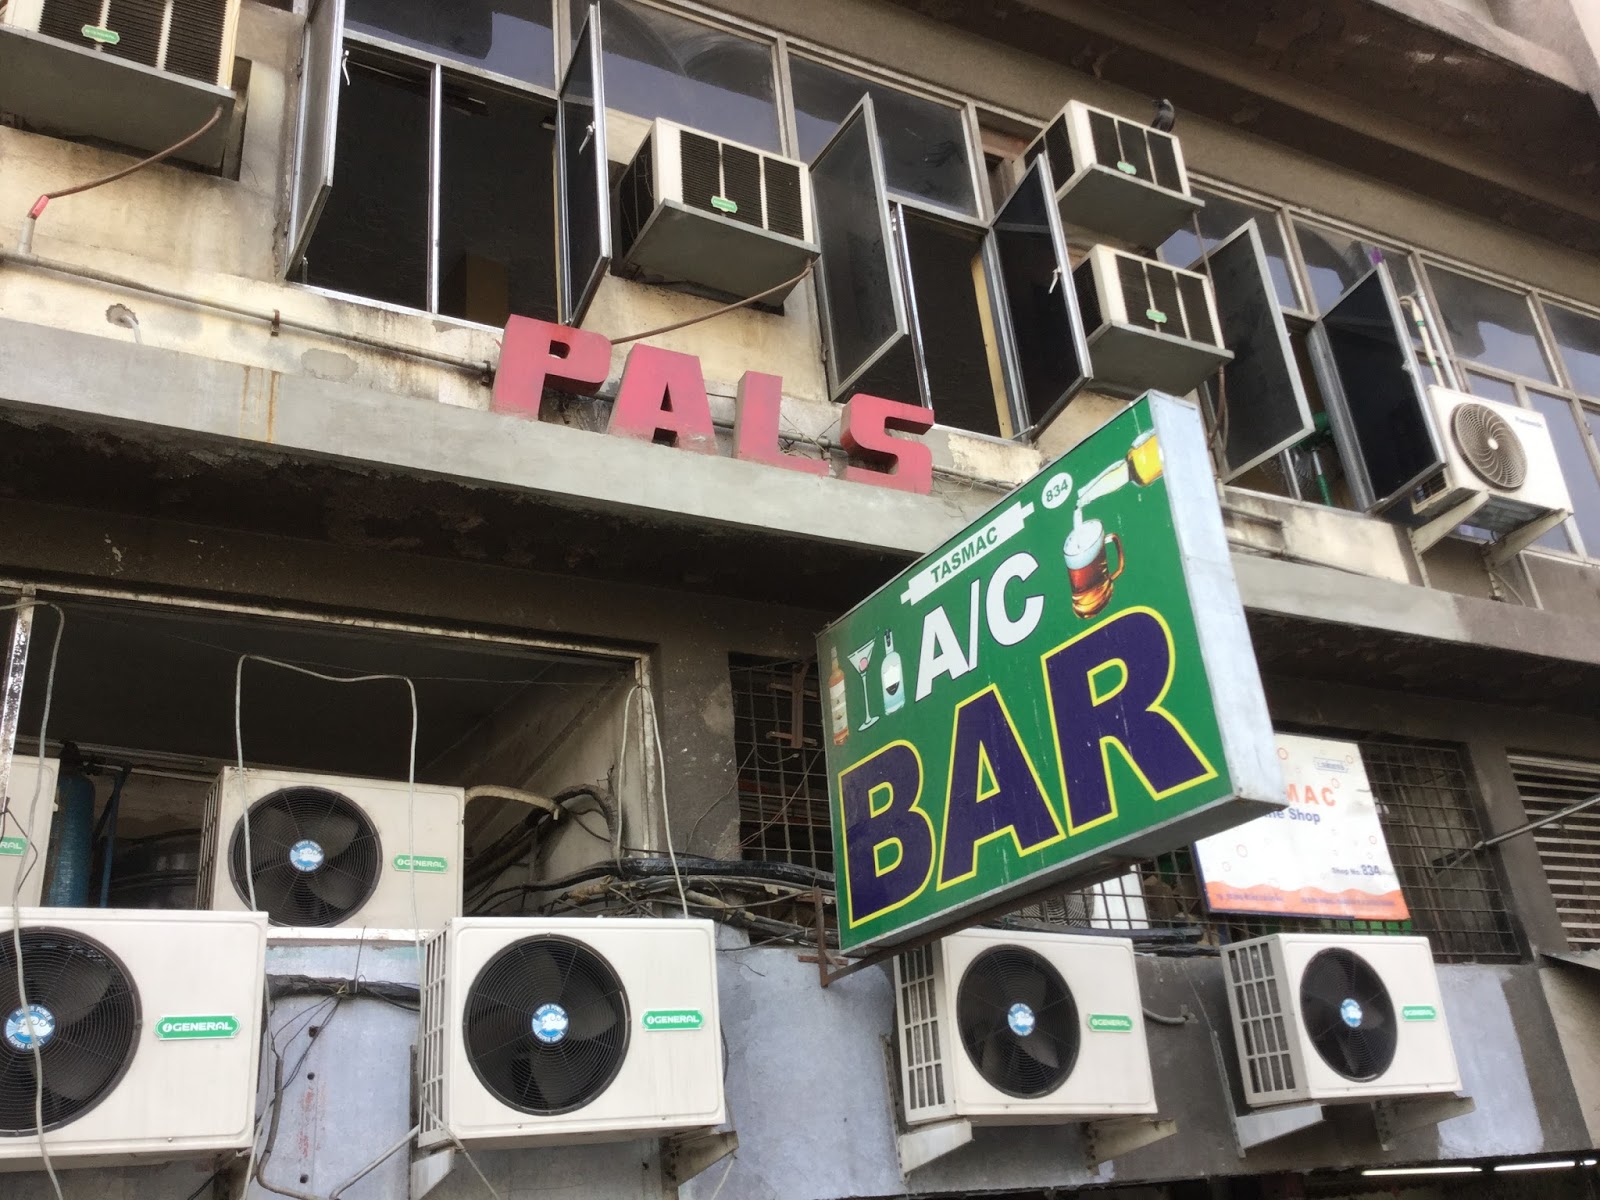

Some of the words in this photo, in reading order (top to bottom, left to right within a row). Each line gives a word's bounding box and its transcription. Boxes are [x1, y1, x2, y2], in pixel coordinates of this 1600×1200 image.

[488, 314, 935, 495] PALS
[1045, 478, 1069, 502] 834
[931, 526, 998, 583] TASMAC
[915, 551, 1045, 702] A/C
[838, 605, 1219, 929] BAR
[1286, 784, 1336, 806] MAC
[1288, 808, 1321, 825] Shop
